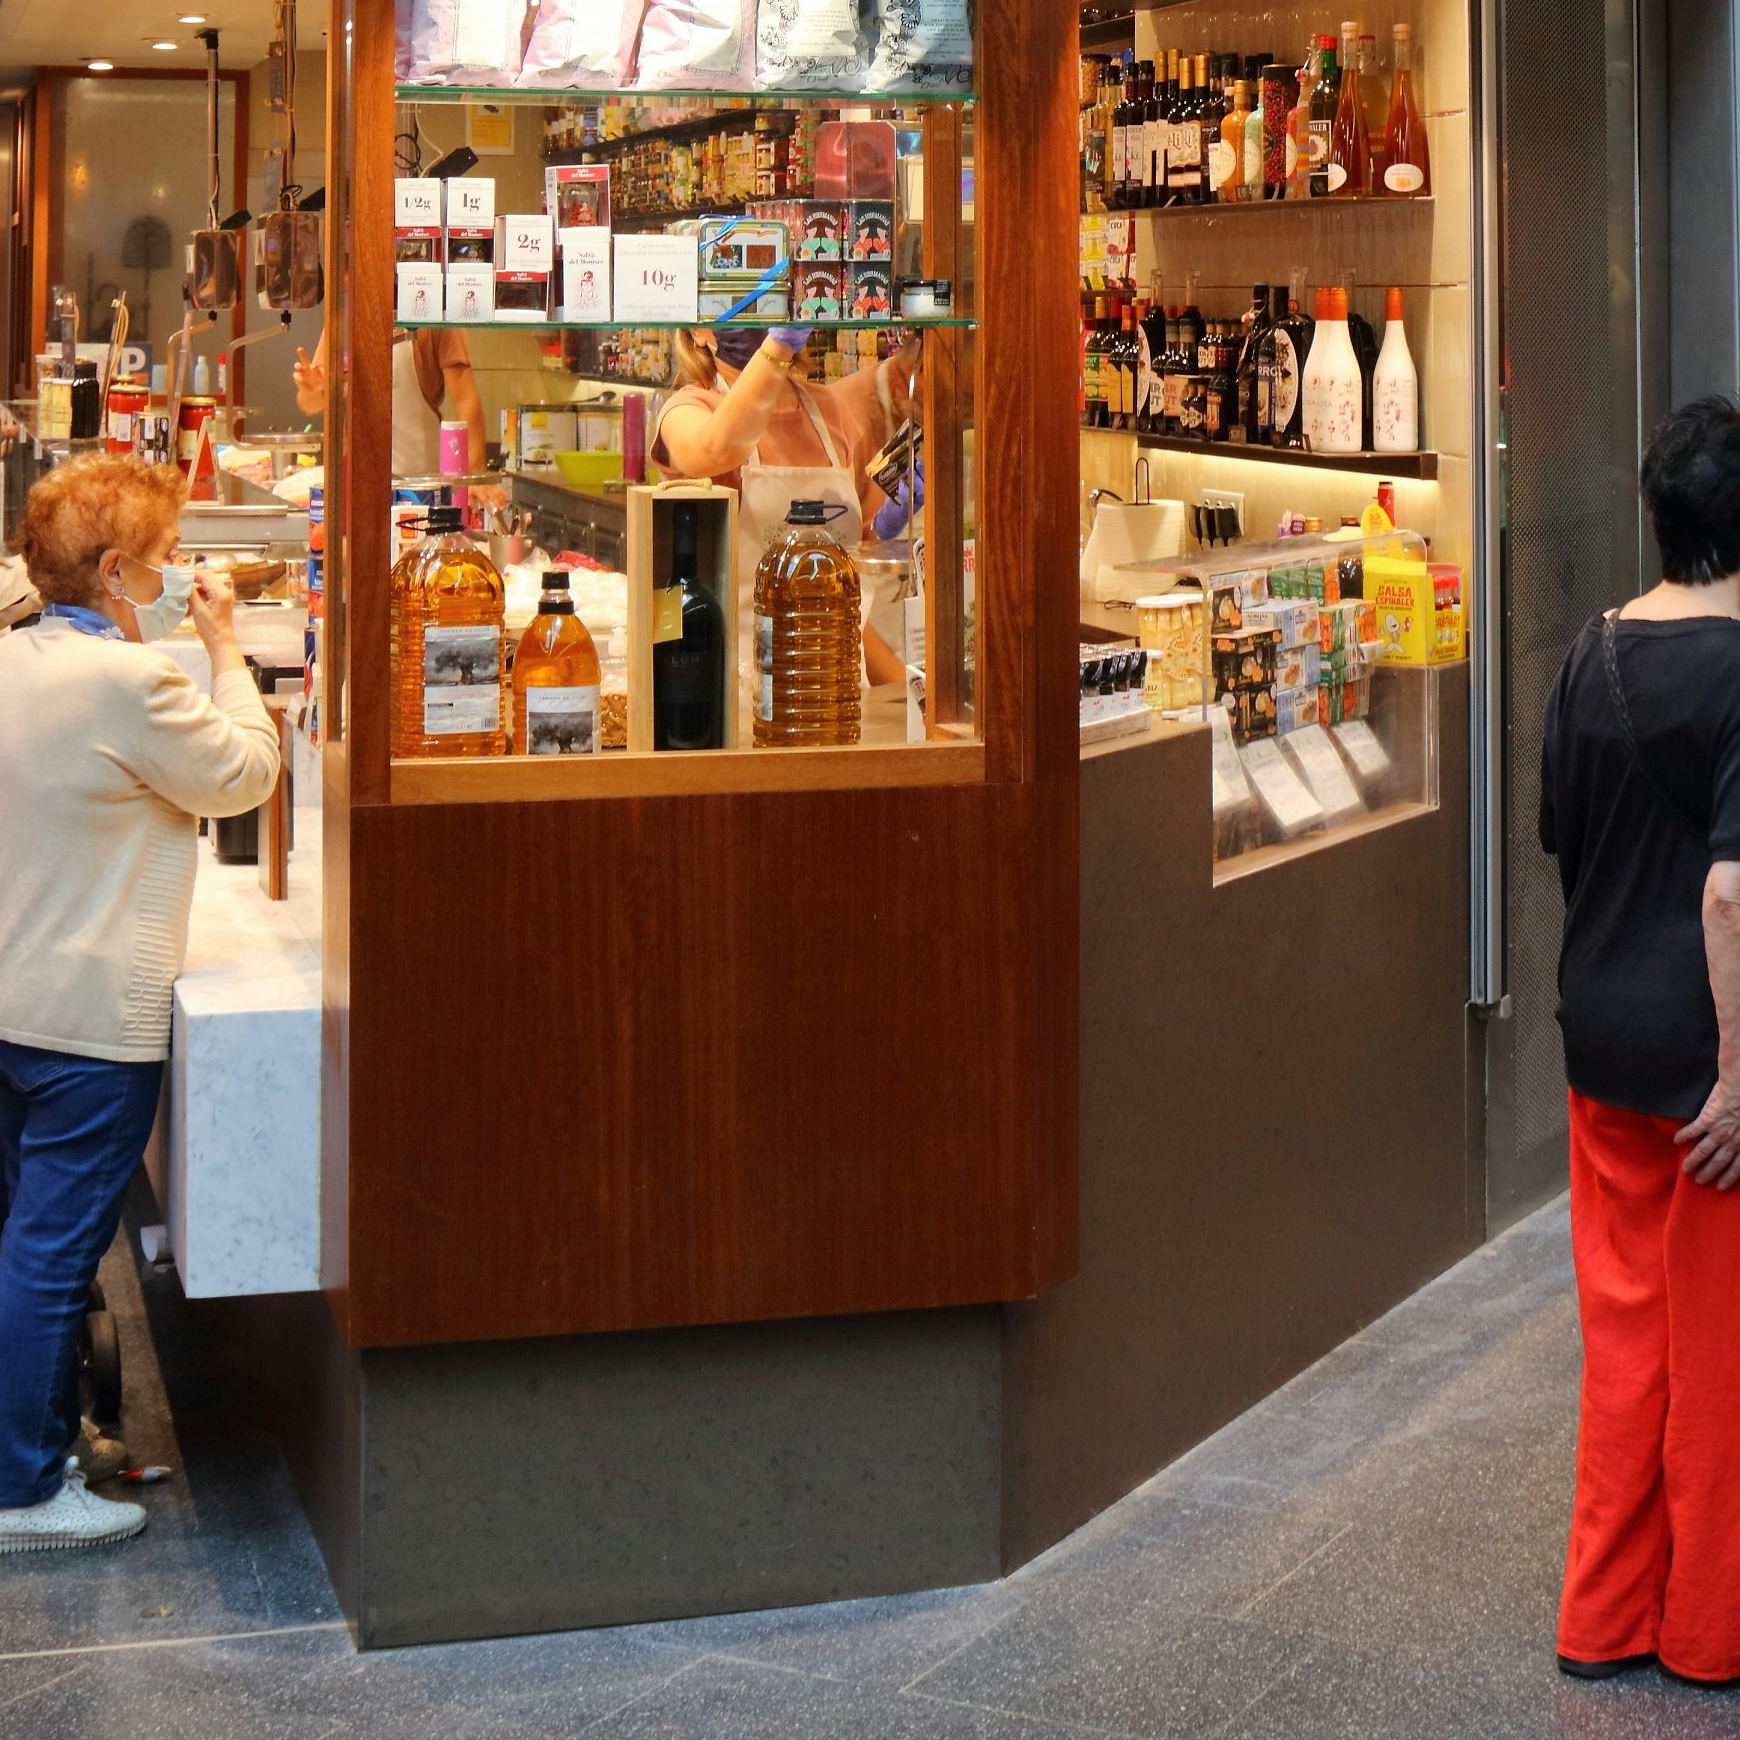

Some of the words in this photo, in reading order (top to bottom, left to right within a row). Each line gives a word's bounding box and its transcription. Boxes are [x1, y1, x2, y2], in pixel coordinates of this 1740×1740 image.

[404, 194, 432, 210] 1/2g
[462, 193, 481, 212] 1g
[517, 234, 541, 252] 2g
[642, 269, 677, 291] 10g
[1377, 585, 1411, 598] SALSA
